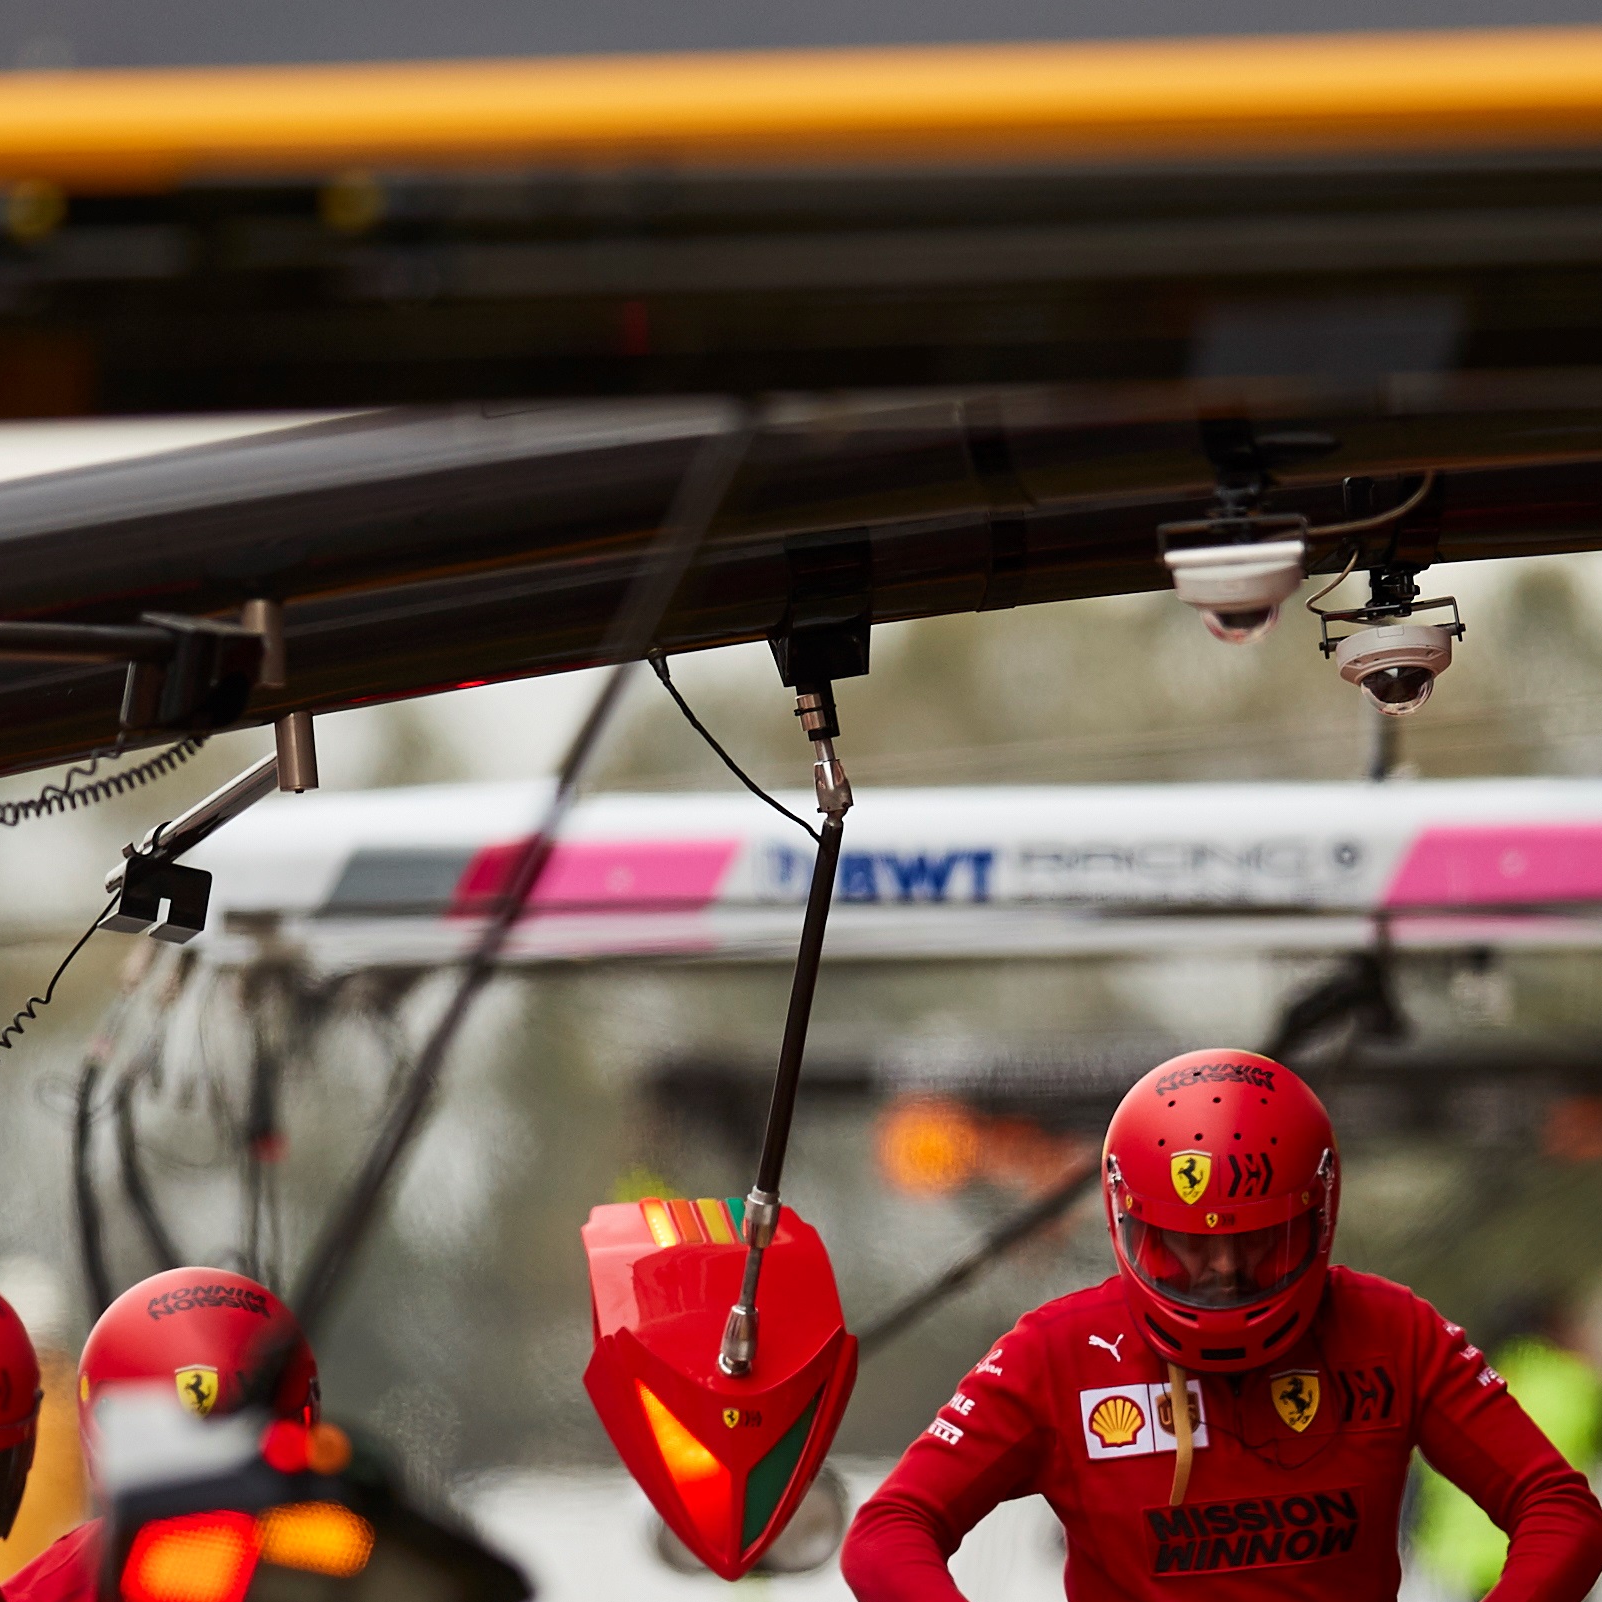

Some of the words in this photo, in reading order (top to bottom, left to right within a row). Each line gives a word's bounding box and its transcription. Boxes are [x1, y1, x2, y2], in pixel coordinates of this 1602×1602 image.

[841, 848, 995, 903] BWT
[949, 1393, 975, 1416] HLE
[1148, 1490, 1358, 1542] MISSION
[1155, 1522, 1358, 1573] WINNOW
